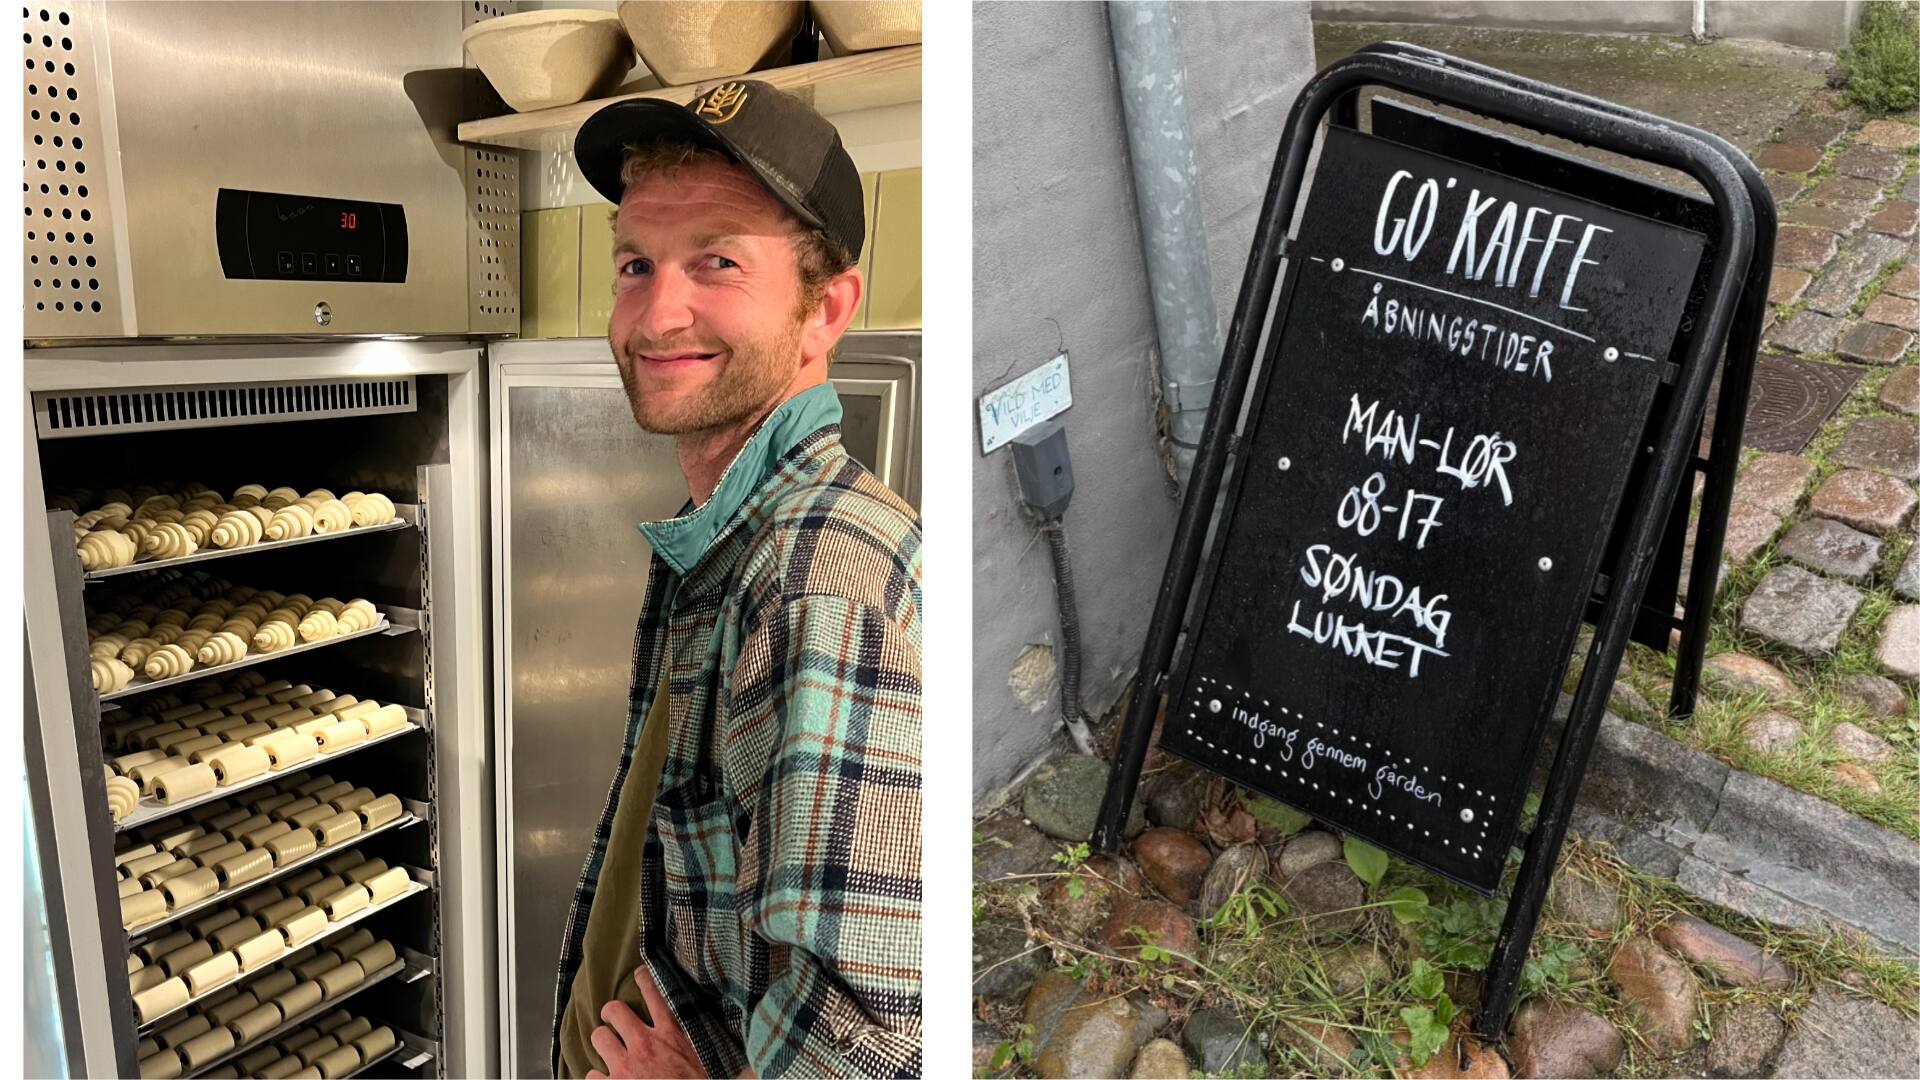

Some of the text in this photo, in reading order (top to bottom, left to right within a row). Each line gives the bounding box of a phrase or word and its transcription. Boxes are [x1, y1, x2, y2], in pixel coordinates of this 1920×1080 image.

[341, 212, 356, 229] 30
[1446, 188, 1614, 312] KAFFE
[1361, 282, 1554, 383] ÅBNINGSTIDER
[985, 372, 1061, 426] VILD MED
[1010, 402, 1041, 428] VILJE
[1342, 392, 1517, 507] MAN-LØR
[1336, 471, 1445, 550] 08-17
[1300, 544, 1451, 648] SØNDAG
[1287, 600, 1451, 678] LUKKET
[1232, 700, 1299, 761] indgang
[1301, 737, 1367, 773] gennem
